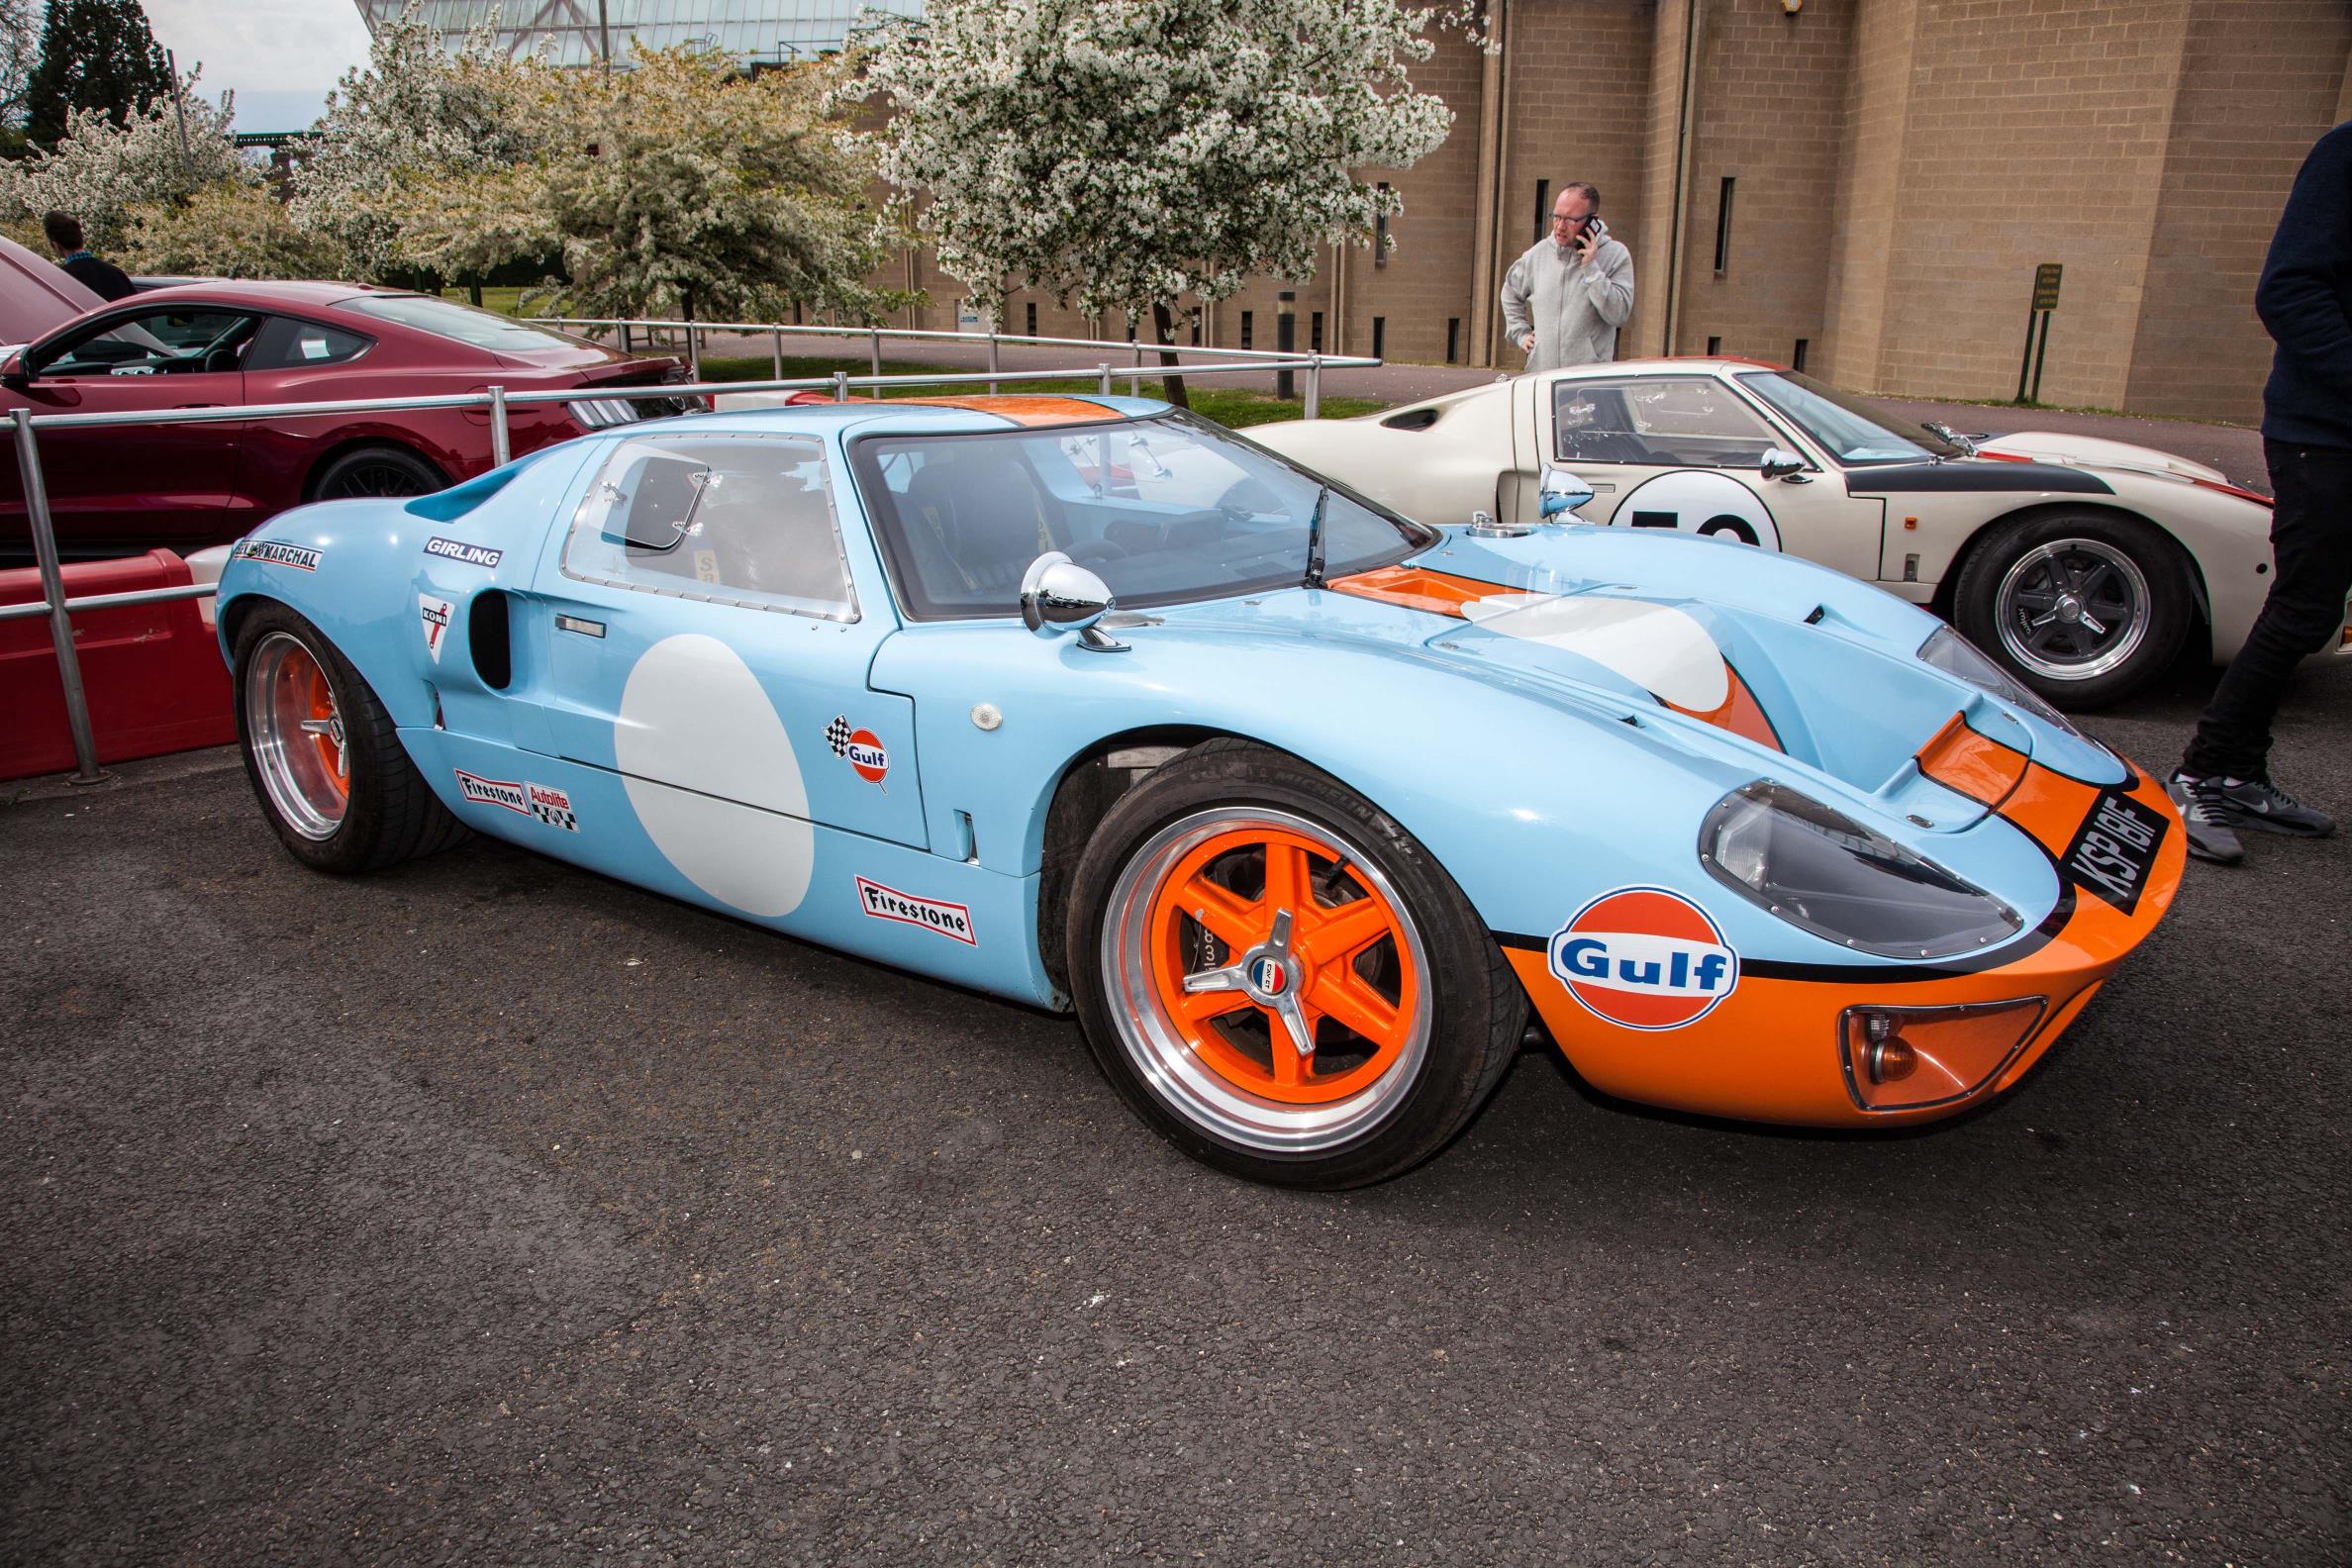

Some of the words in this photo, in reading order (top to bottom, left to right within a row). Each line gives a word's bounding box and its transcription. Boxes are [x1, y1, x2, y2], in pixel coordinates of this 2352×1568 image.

[262, 544, 317, 568] MARCHAL
[427, 539, 500, 565] GIRLING
[423, 609, 446, 625] KONI
[848, 745, 886, 767] Gulf
[461, 777, 523, 806] Firestone
[531, 787, 569, 810] Autolite
[2094, 796, 2156, 854] 181F
[2071, 831, 2140, 898] KSP
[864, 887, 966, 932] Firestone
[1561, 938, 1727, 990] Gulf
